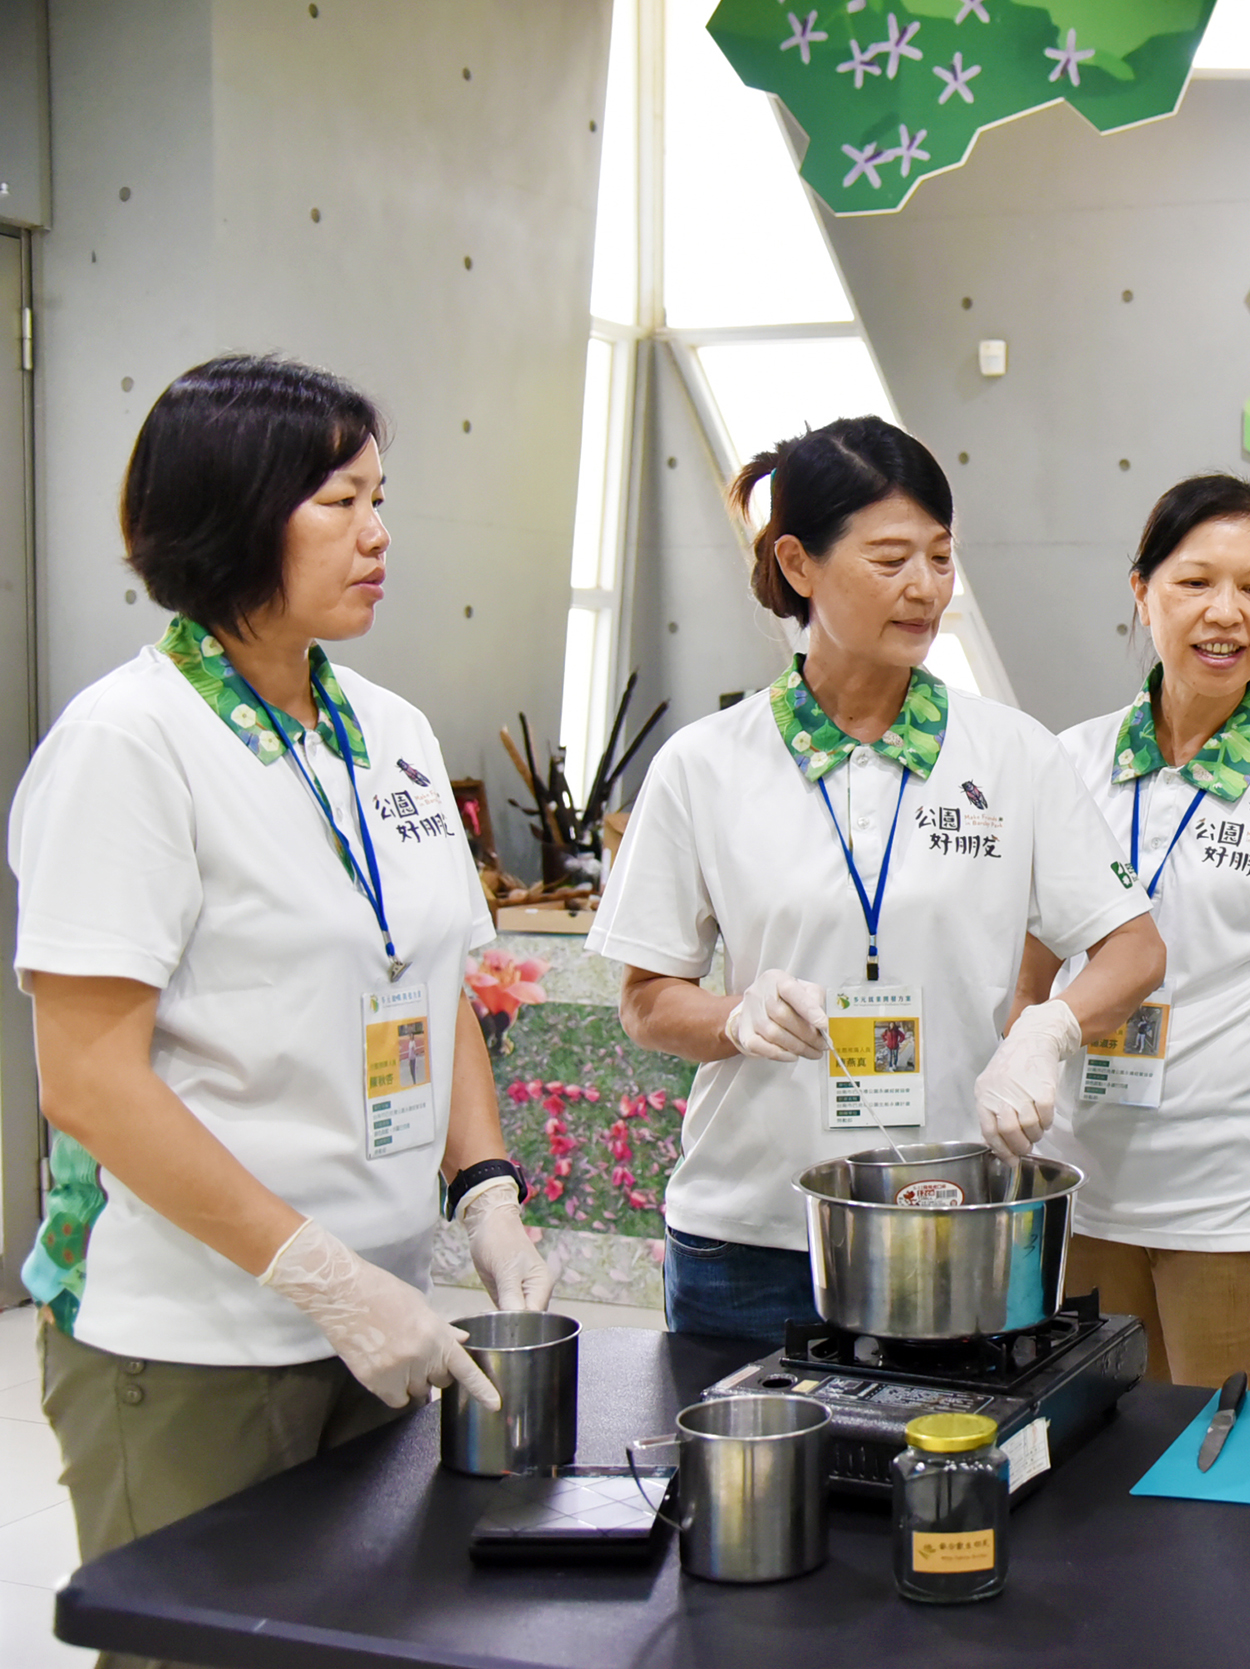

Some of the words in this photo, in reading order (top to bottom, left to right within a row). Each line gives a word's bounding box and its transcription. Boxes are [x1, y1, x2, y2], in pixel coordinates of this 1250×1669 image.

[374, 790, 419, 820] 公園
[915, 806, 961, 832] 公園
[929, 833, 1002, 859] 好朋友
[1195, 820, 1245, 847] 公園
